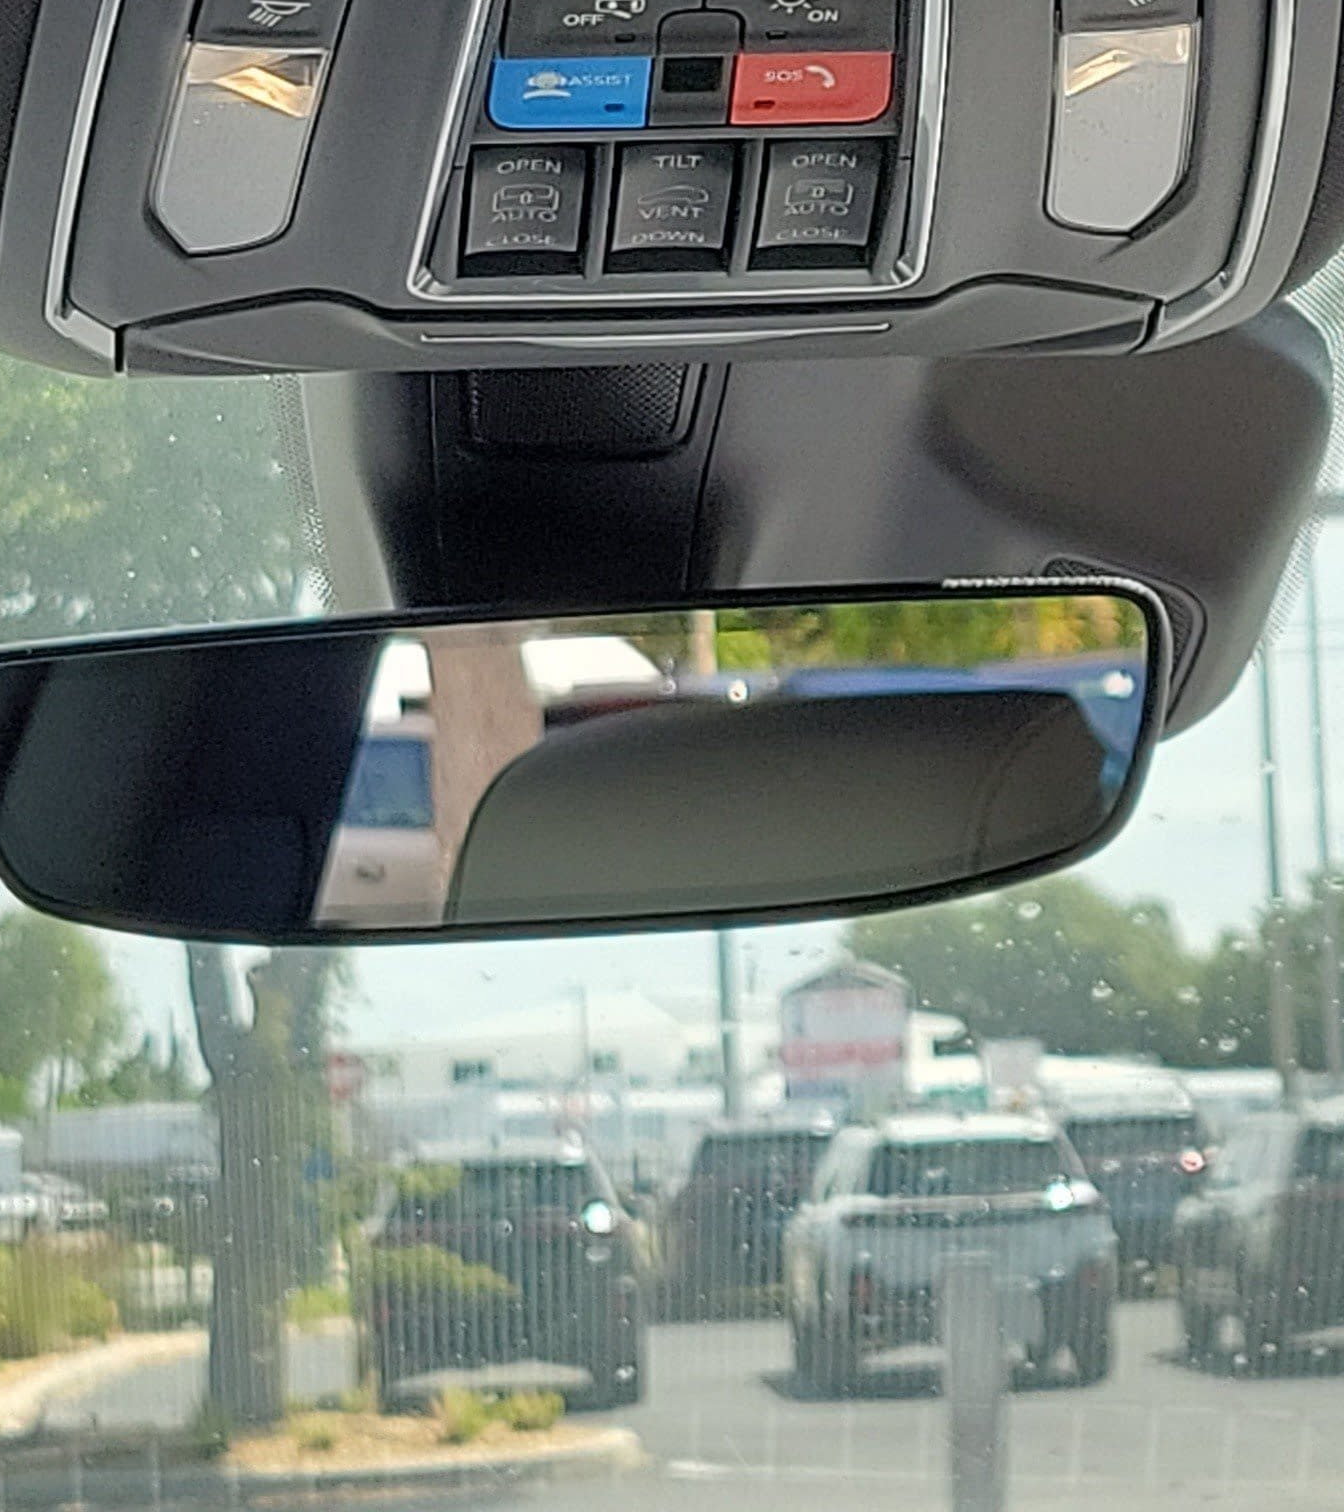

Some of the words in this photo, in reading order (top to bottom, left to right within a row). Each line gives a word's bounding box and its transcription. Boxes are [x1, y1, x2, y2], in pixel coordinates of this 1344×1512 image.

[562, 13, 605, 27] OFF
[807, 8, 839, 23] ON
[567, 74, 632, 86] ASSIST
[763, 69, 804, 83] SOS
[497, 158, 562, 175] OPEN
[652, 154, 703, 169] TILT
[792, 153, 857, 169] OPEN
[492, 209, 558, 223] AUTO
[638, 205, 704, 220] VENT
[784, 201, 849, 217] AUTO
[631, 230, 706, 244] DOWN
